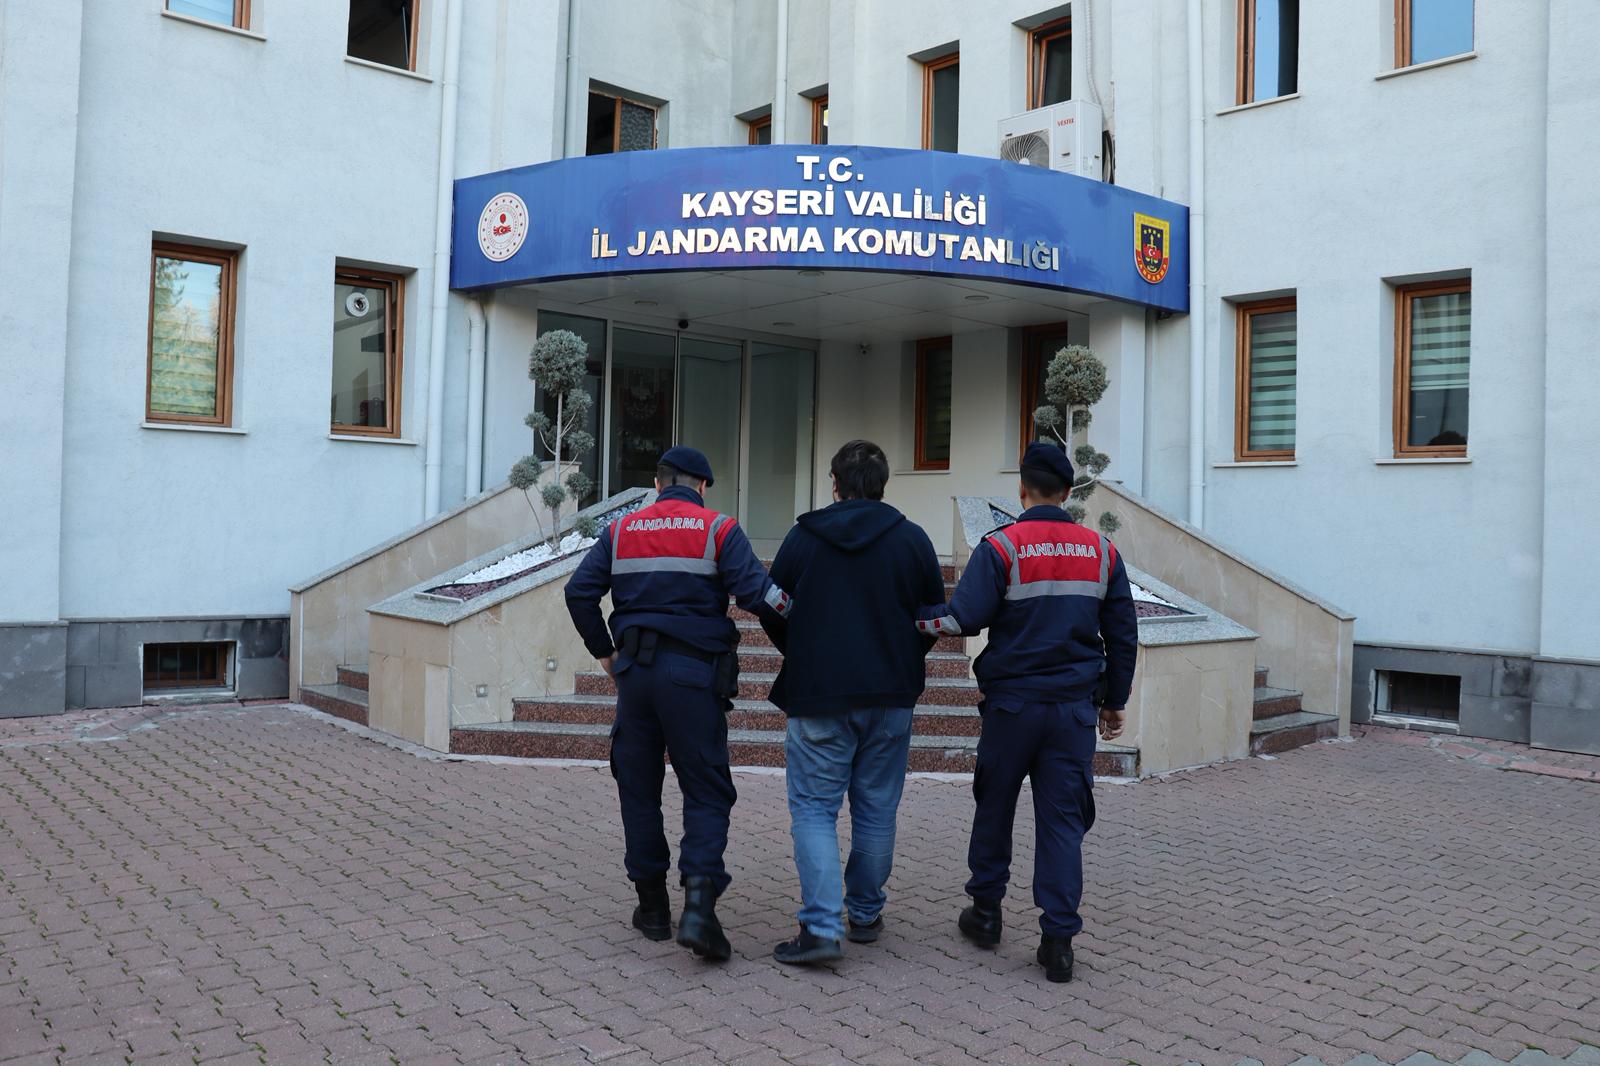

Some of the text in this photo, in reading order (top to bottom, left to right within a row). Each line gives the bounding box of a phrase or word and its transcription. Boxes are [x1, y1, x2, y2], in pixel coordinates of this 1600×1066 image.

[796, 156, 864, 182] T.C.
[682, 184, 987, 226] KAYSERİ VALİLİĞİ
[592, 227, 1060, 272] İL JANDARMA KOMUTANLIĞI
[626, 517, 705, 532] JANDARMA
[1017, 542, 1098, 559] JANDARMA
